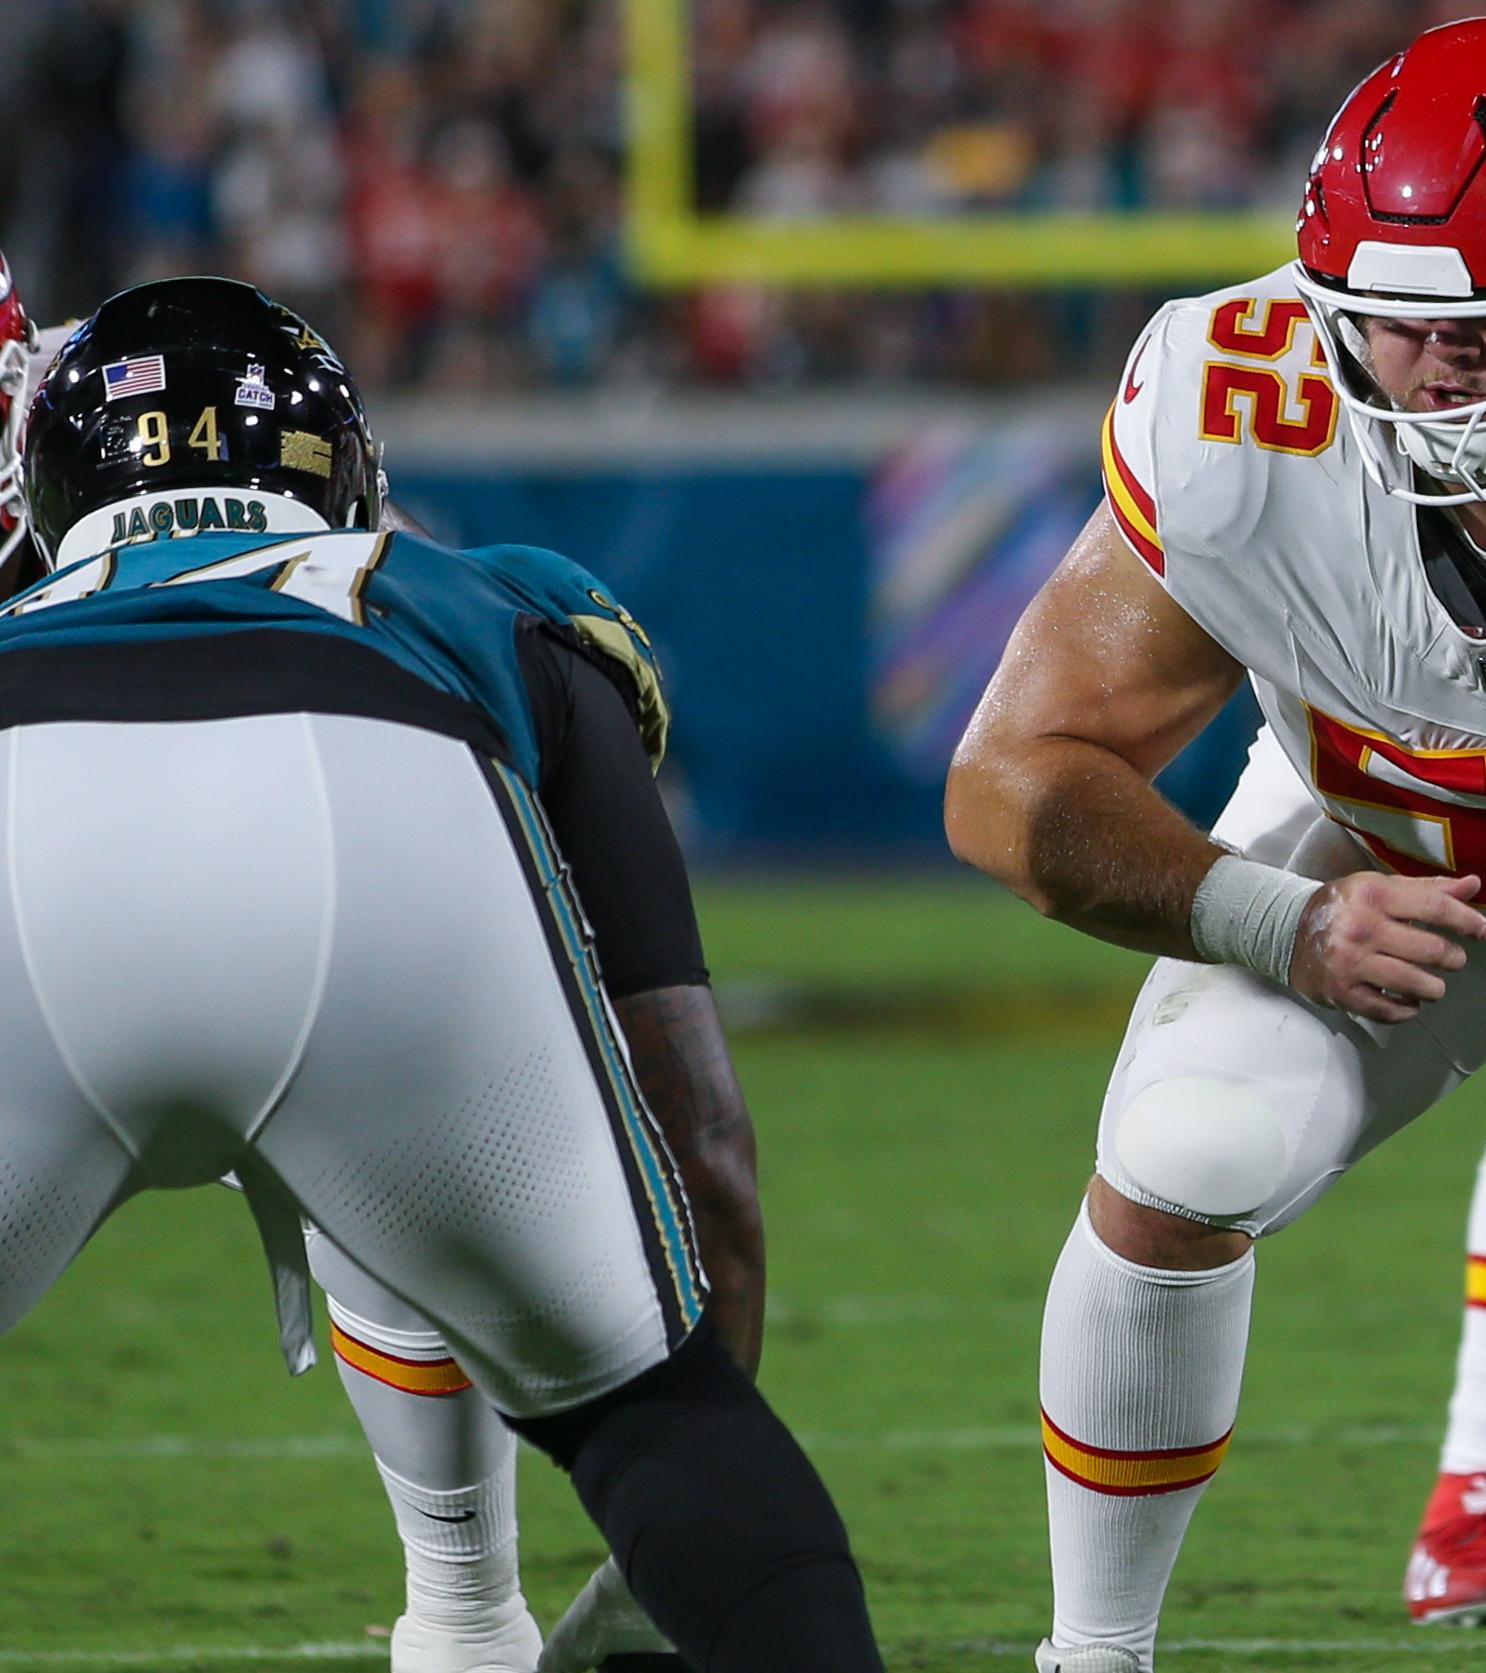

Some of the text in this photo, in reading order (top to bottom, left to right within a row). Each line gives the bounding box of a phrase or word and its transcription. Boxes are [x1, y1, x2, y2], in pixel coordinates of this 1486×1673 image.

[238, 388, 273, 403] CATCH
[1200, 298, 1340, 456] 52
[137, 406, 222, 466] 94
[112, 498, 267, 544] JAGUARS
